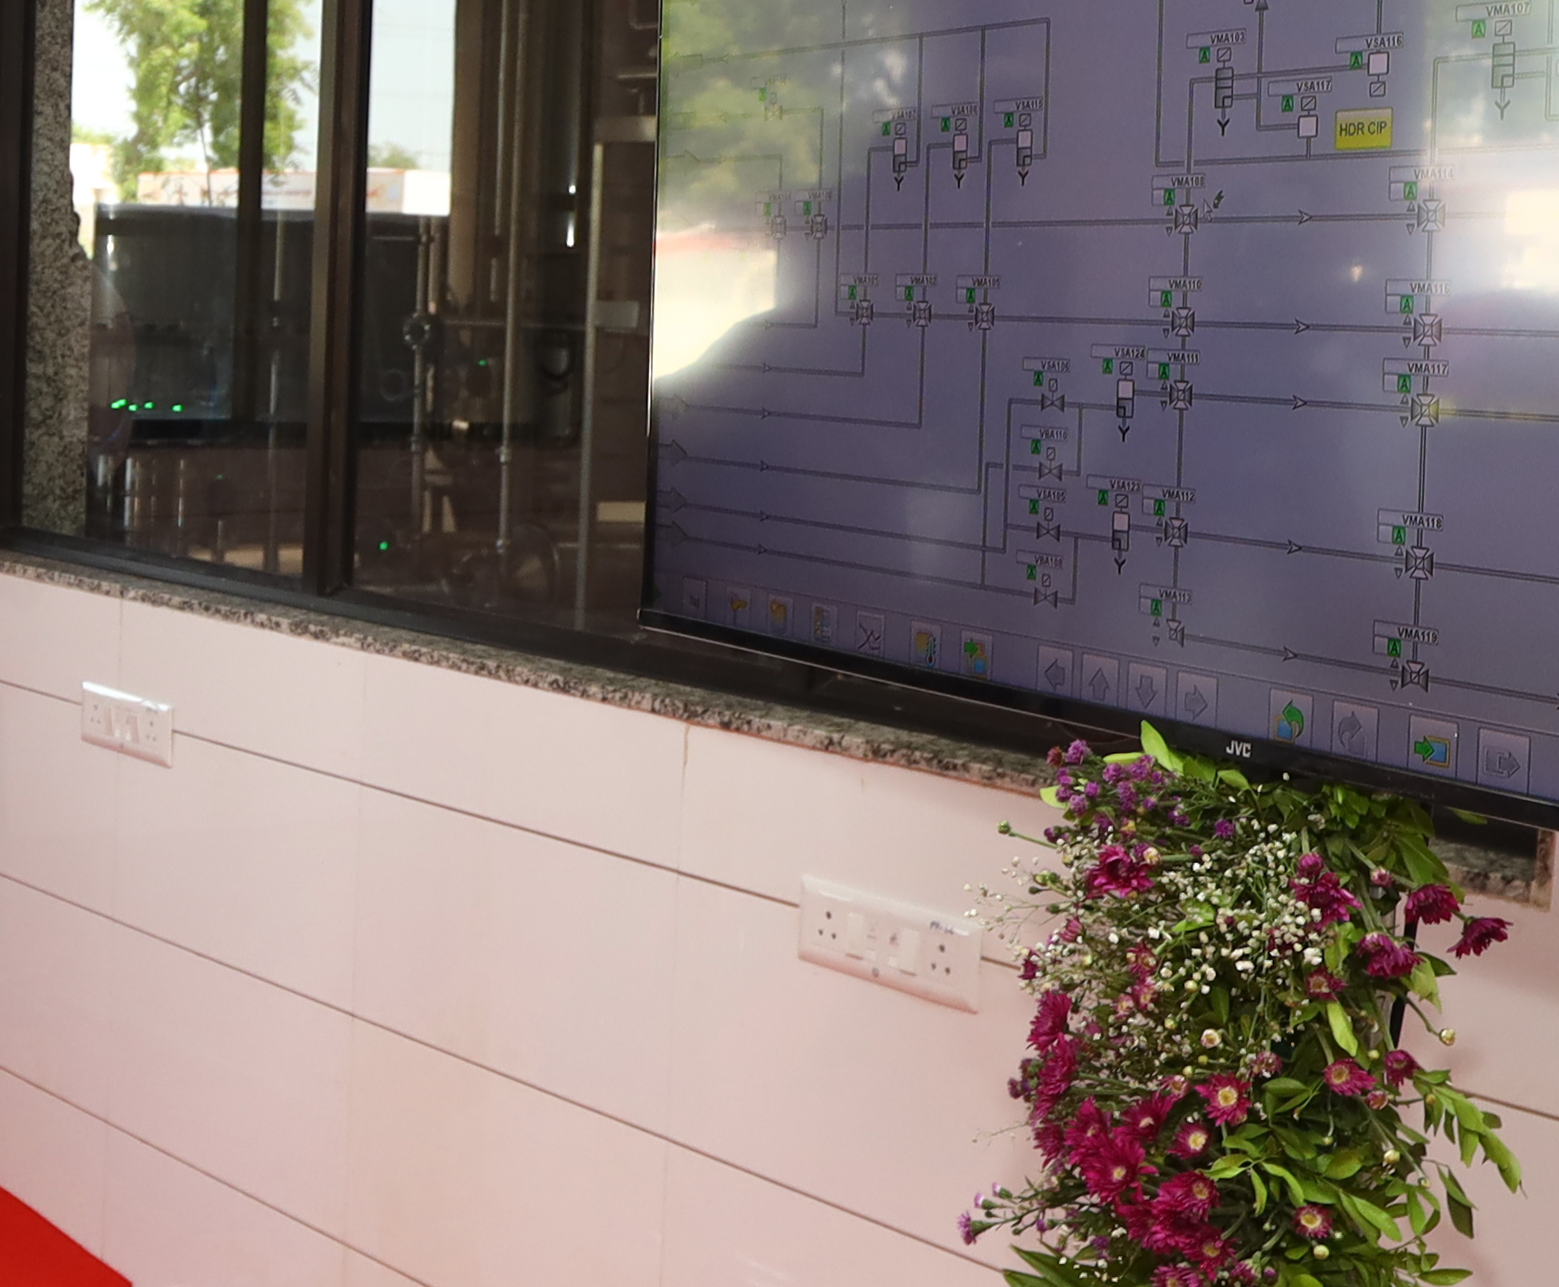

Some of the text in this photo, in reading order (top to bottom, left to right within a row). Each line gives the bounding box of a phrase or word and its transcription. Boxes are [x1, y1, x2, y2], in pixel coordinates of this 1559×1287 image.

[1365, 35, 1403, 49] VSA116
[1339, 120, 1388, 137] HDR CIP
[1225, 740, 1252, 759] JVC
